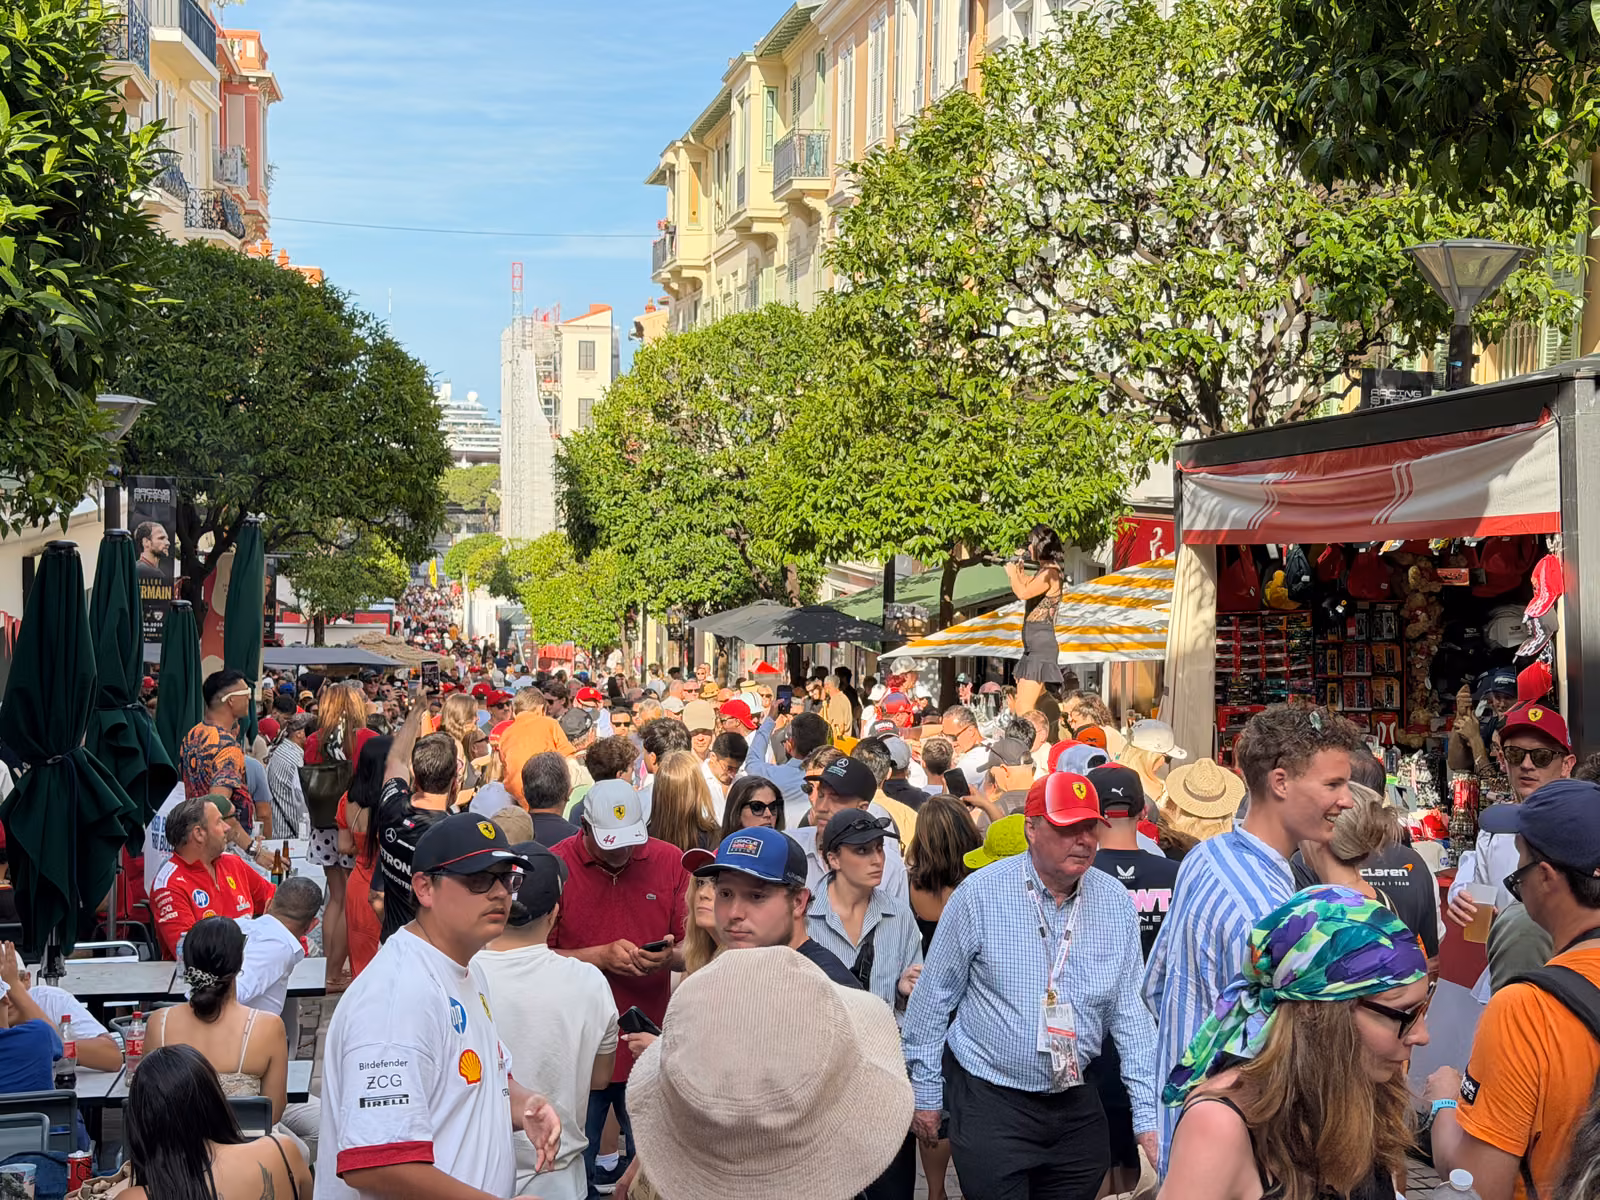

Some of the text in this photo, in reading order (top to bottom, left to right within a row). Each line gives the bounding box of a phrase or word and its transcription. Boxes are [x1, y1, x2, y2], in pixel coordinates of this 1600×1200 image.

[141, 585, 172, 600] RMAIN
[603, 834, 616, 844] 44
[359, 1059, 408, 1071] Bitdefender
[366, 1074, 402, 1090] ZCG
[359, 1094, 409, 1109] PIRELLI
